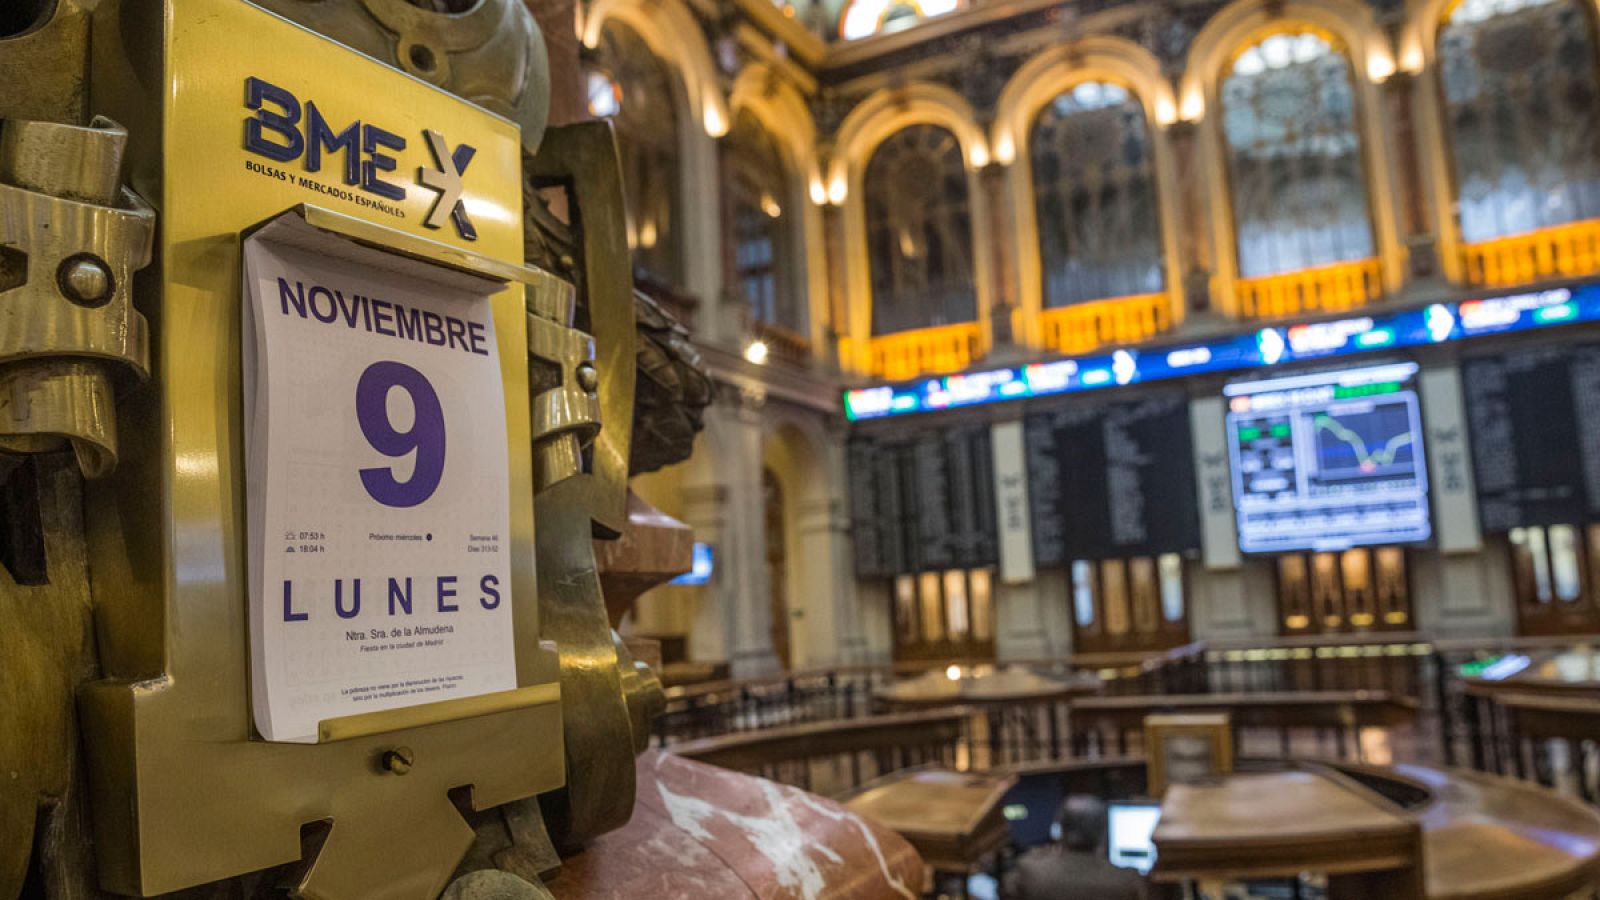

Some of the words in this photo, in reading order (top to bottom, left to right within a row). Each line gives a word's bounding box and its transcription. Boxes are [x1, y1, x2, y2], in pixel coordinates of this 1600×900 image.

[246, 160, 286, 181] BOLSAS
[288, 173, 296, 184] Y
[298, 177, 354, 202] MERCADOS
[355, 195, 405, 218] ESPAÑOLES
[277, 277, 489, 356] NOVIEMBRE
[355, 360, 446, 508] 9
[299, 531, 319, 540] 07:53
[320, 531, 325, 540] h
[368, 532, 393, 541] Próximo
[299, 544, 318, 553] 18:04
[319, 544, 325, 553] h
[283, 574, 501, 622] LUNES
[346, 630, 367, 641] Ntra.
[370, 628, 388, 640] Sra.
[390, 627, 402, 638] de
[404, 626, 412, 637] la
[414, 624, 454, 636] Almudena
[360, 644, 379, 653] Fiesta
[416, 640, 424, 648] de
[424, 638, 444, 647] Madrid
